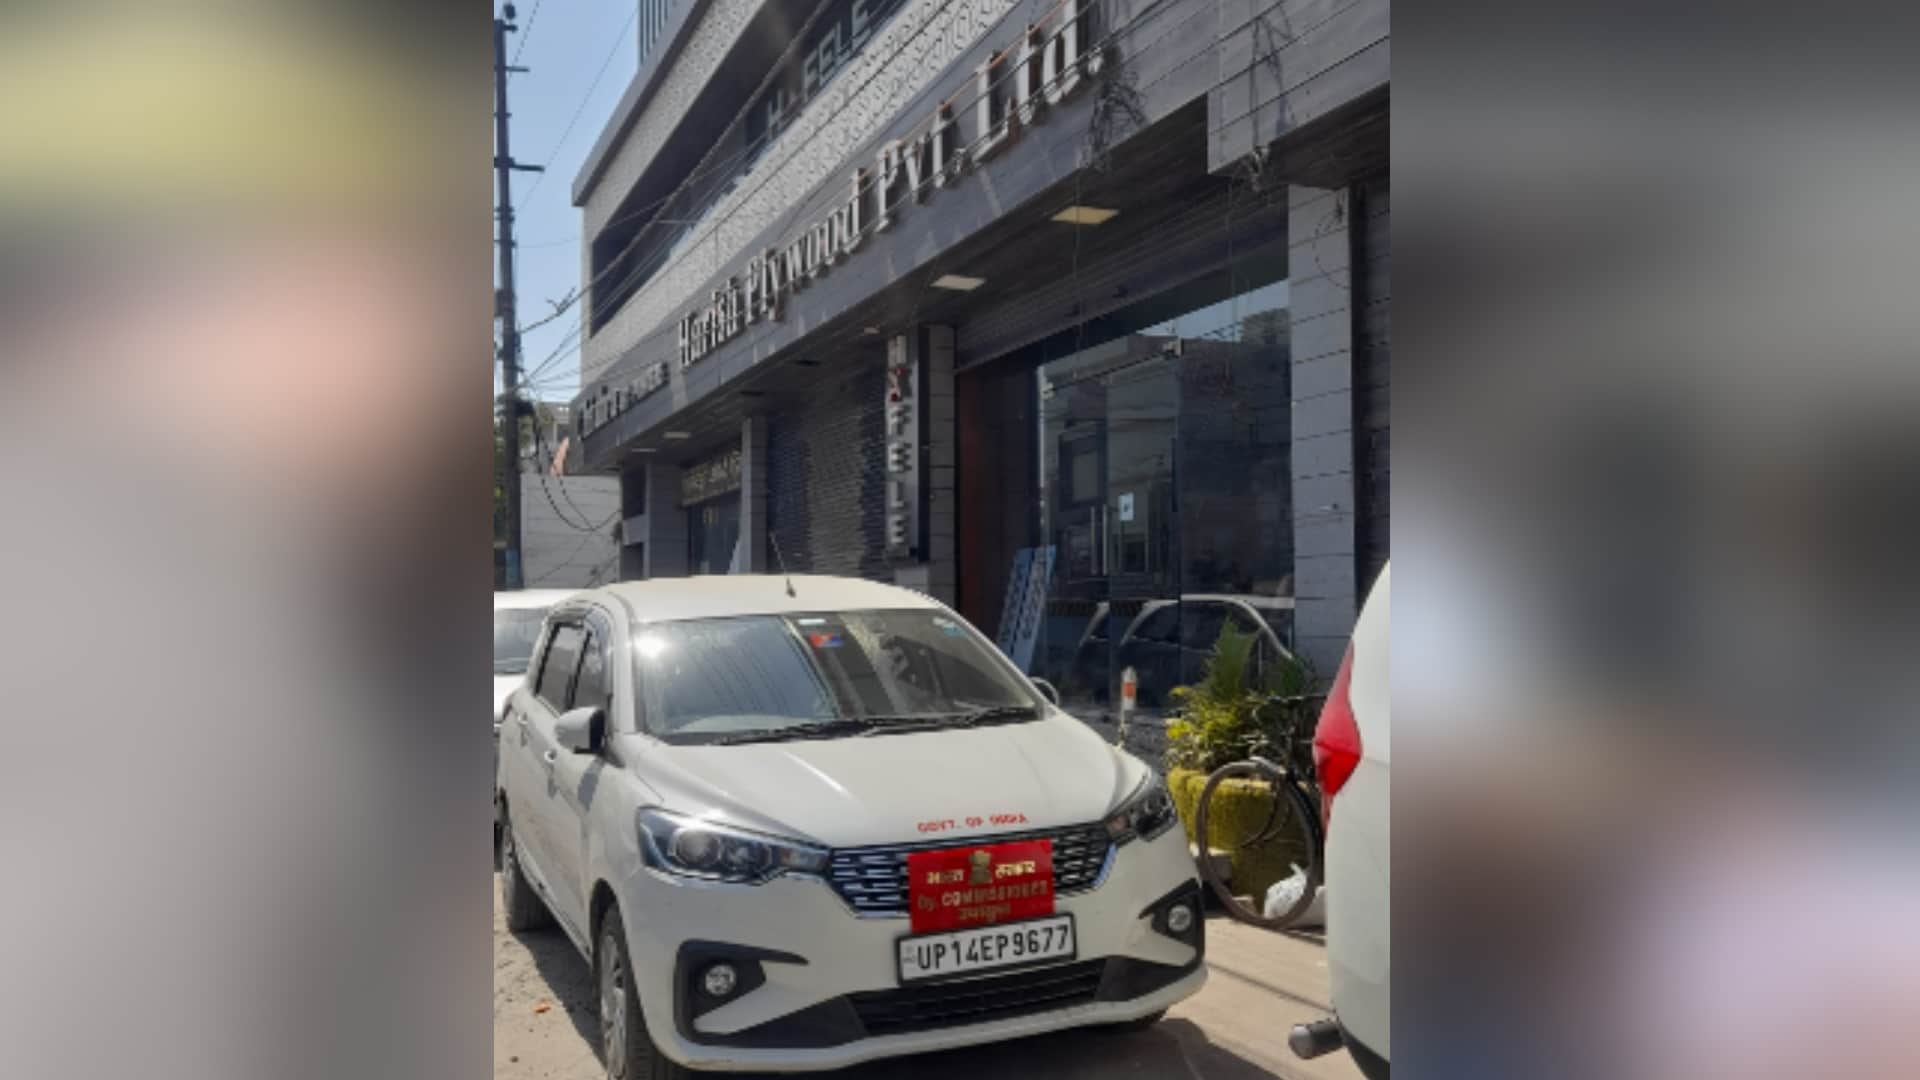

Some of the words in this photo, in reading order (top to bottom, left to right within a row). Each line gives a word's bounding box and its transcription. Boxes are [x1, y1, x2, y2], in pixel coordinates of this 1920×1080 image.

[767, 0, 873, 142] HFELE
[678, 276, 738, 368] Harish
[745, 168, 864, 324] Plywood
[876, 102, 966, 232] Pvt.
[973, 0, 1103, 162] Ltd.
[917, 925, 1069, 970] UP14EP9677
